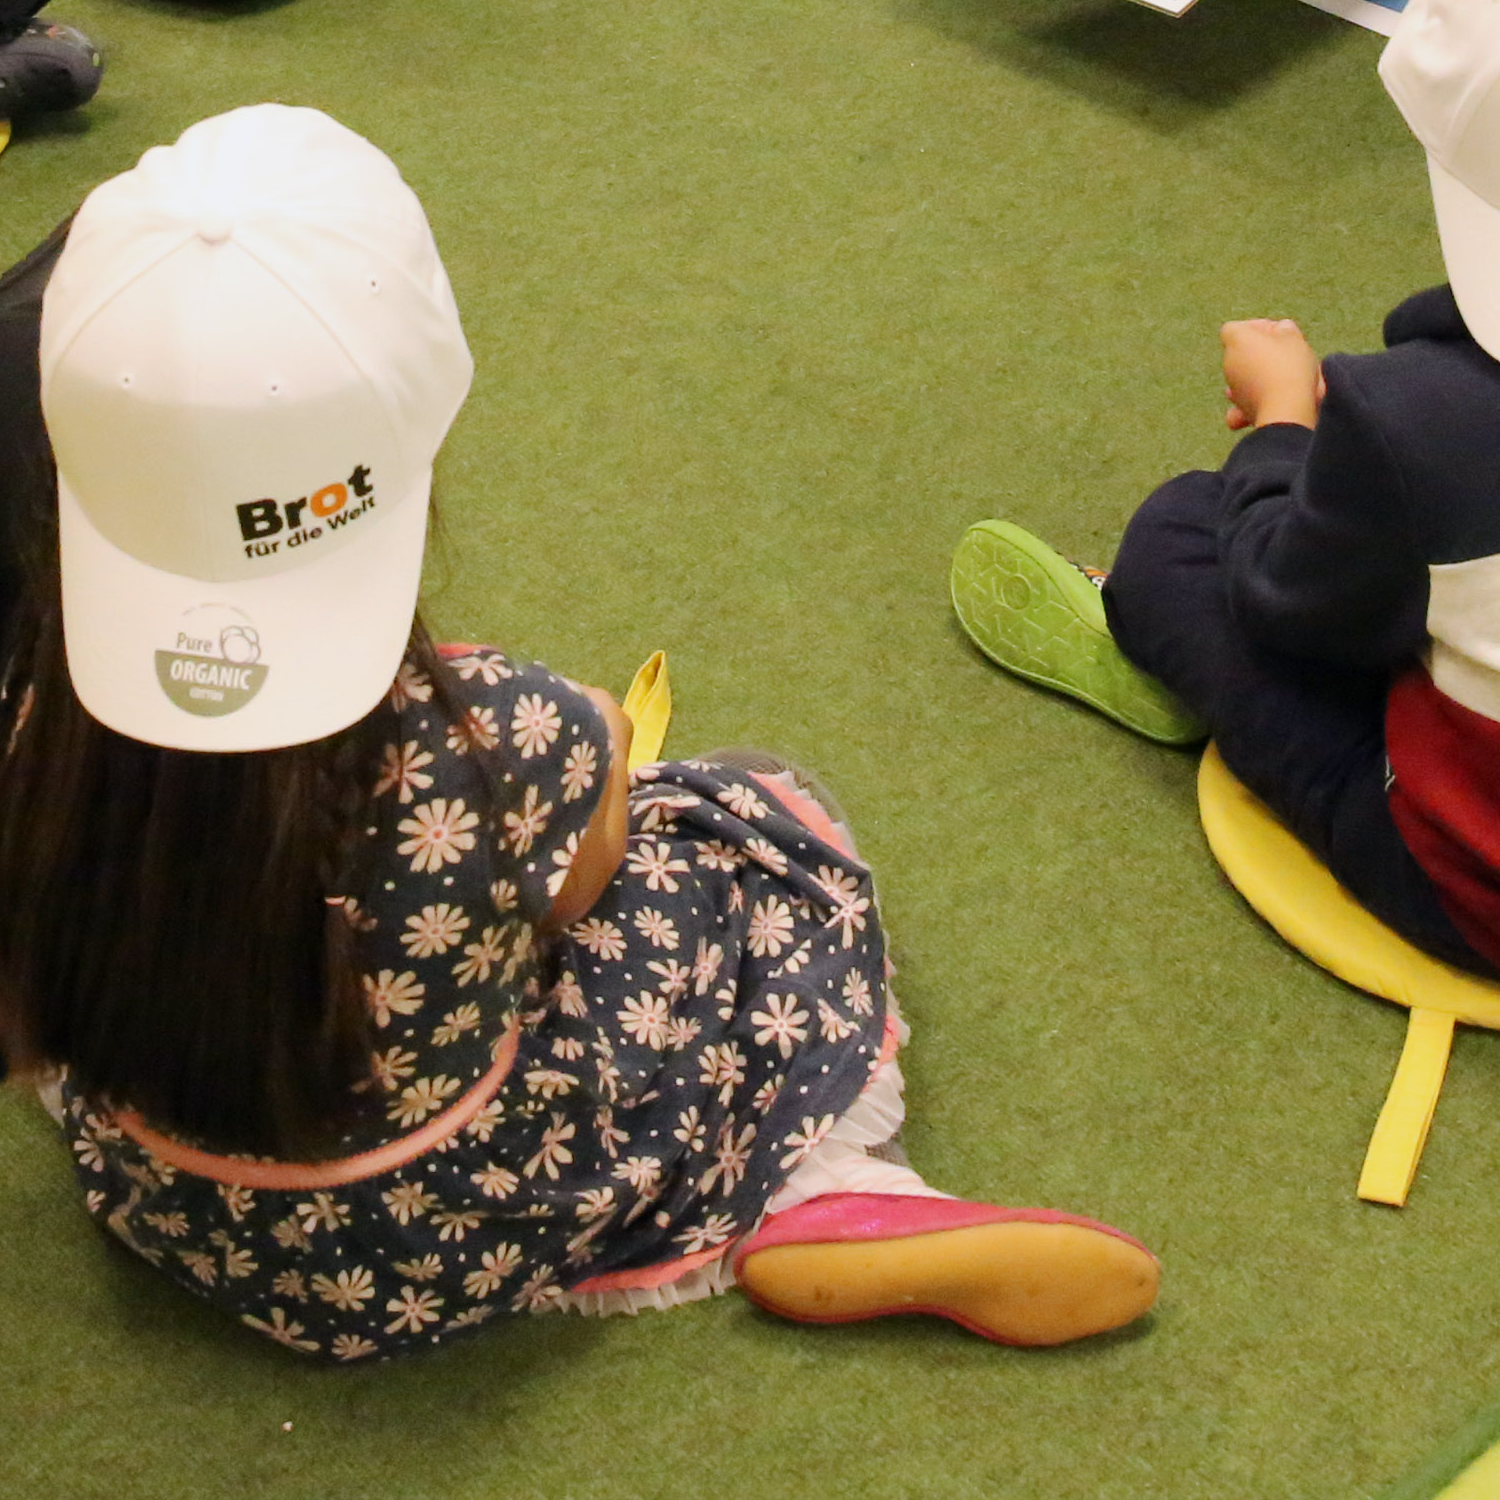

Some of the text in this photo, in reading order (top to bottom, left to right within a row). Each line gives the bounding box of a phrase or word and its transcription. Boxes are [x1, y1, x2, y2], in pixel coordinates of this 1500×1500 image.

[236, 464, 374, 541] Brot
[244, 496, 376, 559] für die Welt
[176, 632, 213, 653] Pure
[170, 659, 253, 691] ORGANIC
